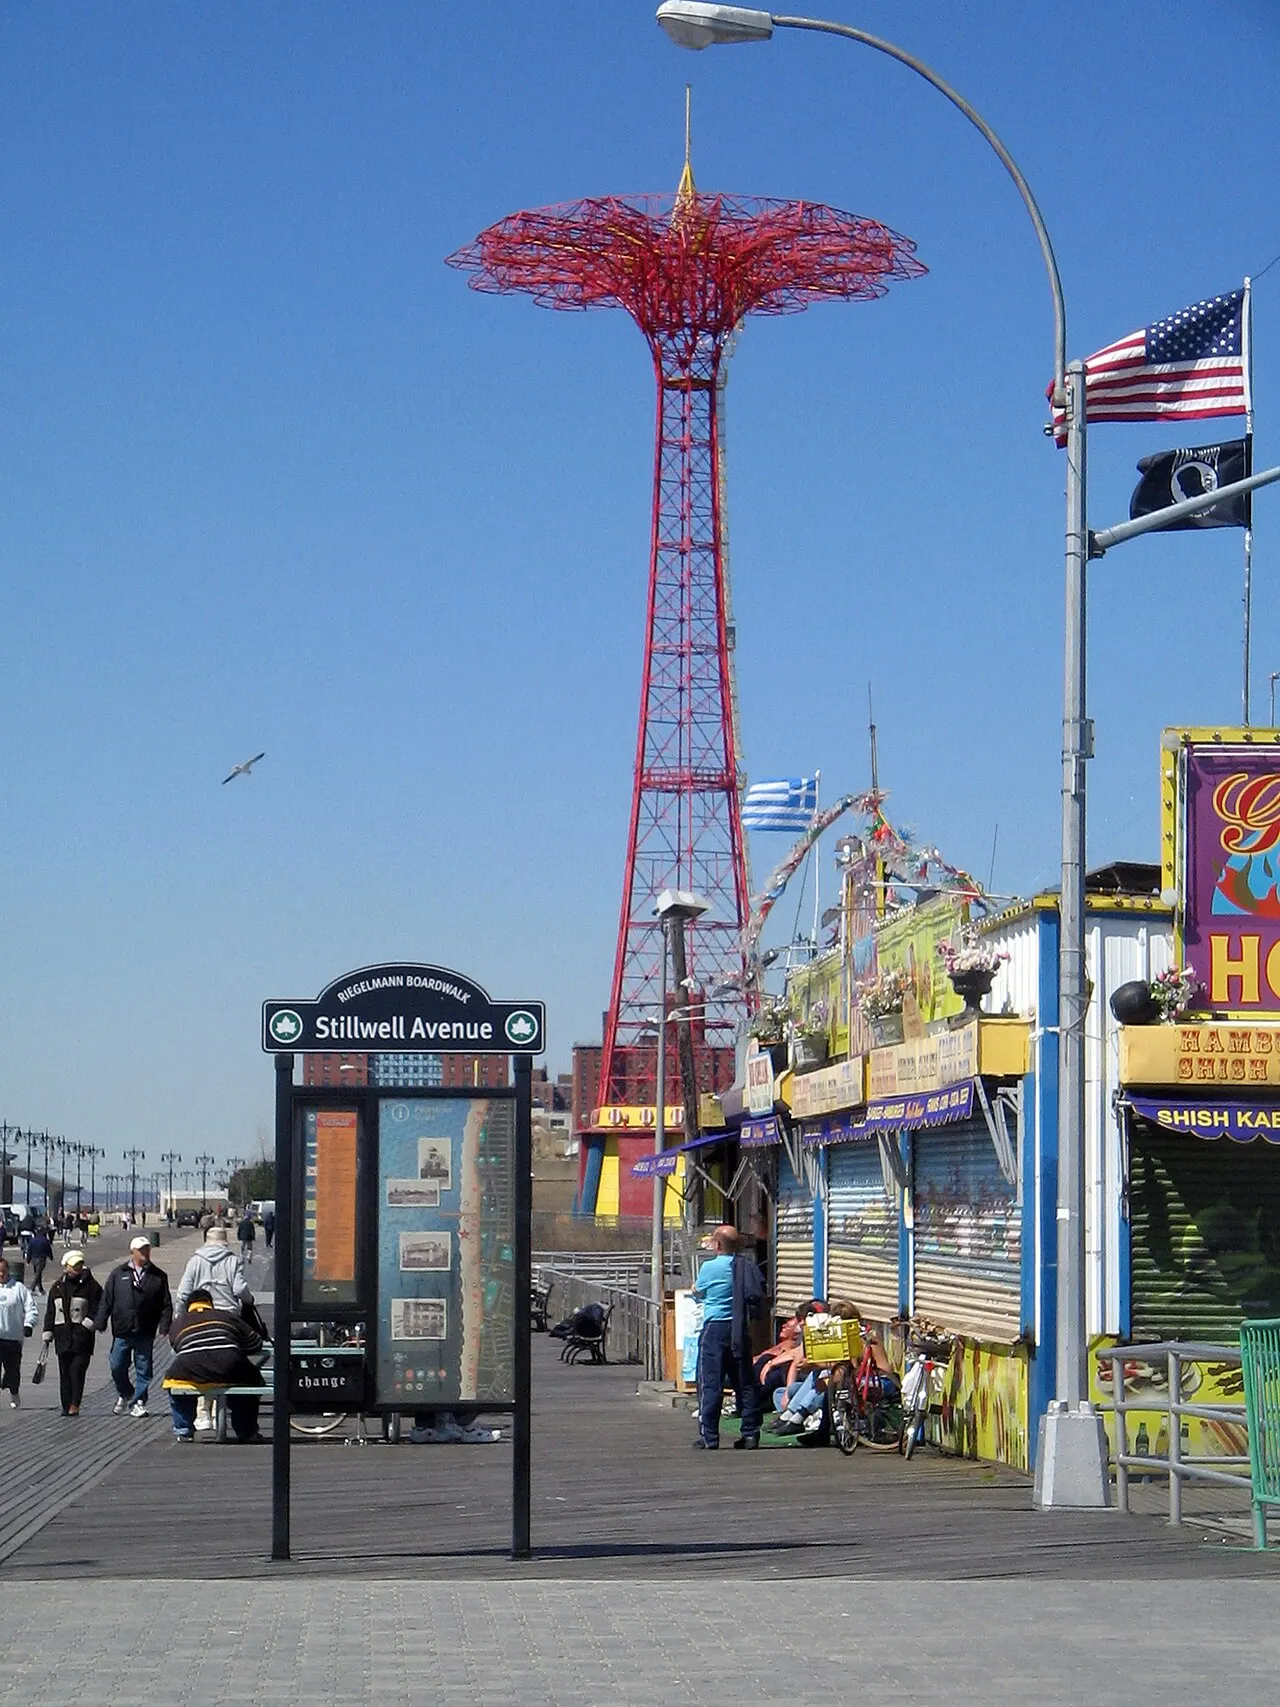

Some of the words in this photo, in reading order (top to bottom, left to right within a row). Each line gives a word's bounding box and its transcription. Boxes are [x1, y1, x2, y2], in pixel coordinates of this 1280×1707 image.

[1209, 934, 1280, 1003] H
[336, 975, 404, 1004] RIEGELMANN
[406, 975, 471, 1005] BOARDWALK
[315, 1015, 405, 1040] Stillwell
[410, 1016, 493, 1040] Avenue
[1180, 1029, 1280, 1053] HAMB
[1178, 1057, 1268, 1080] SHISH
[1157, 1109, 1230, 1128] SHISH
[298, 1376, 346, 1388] change
